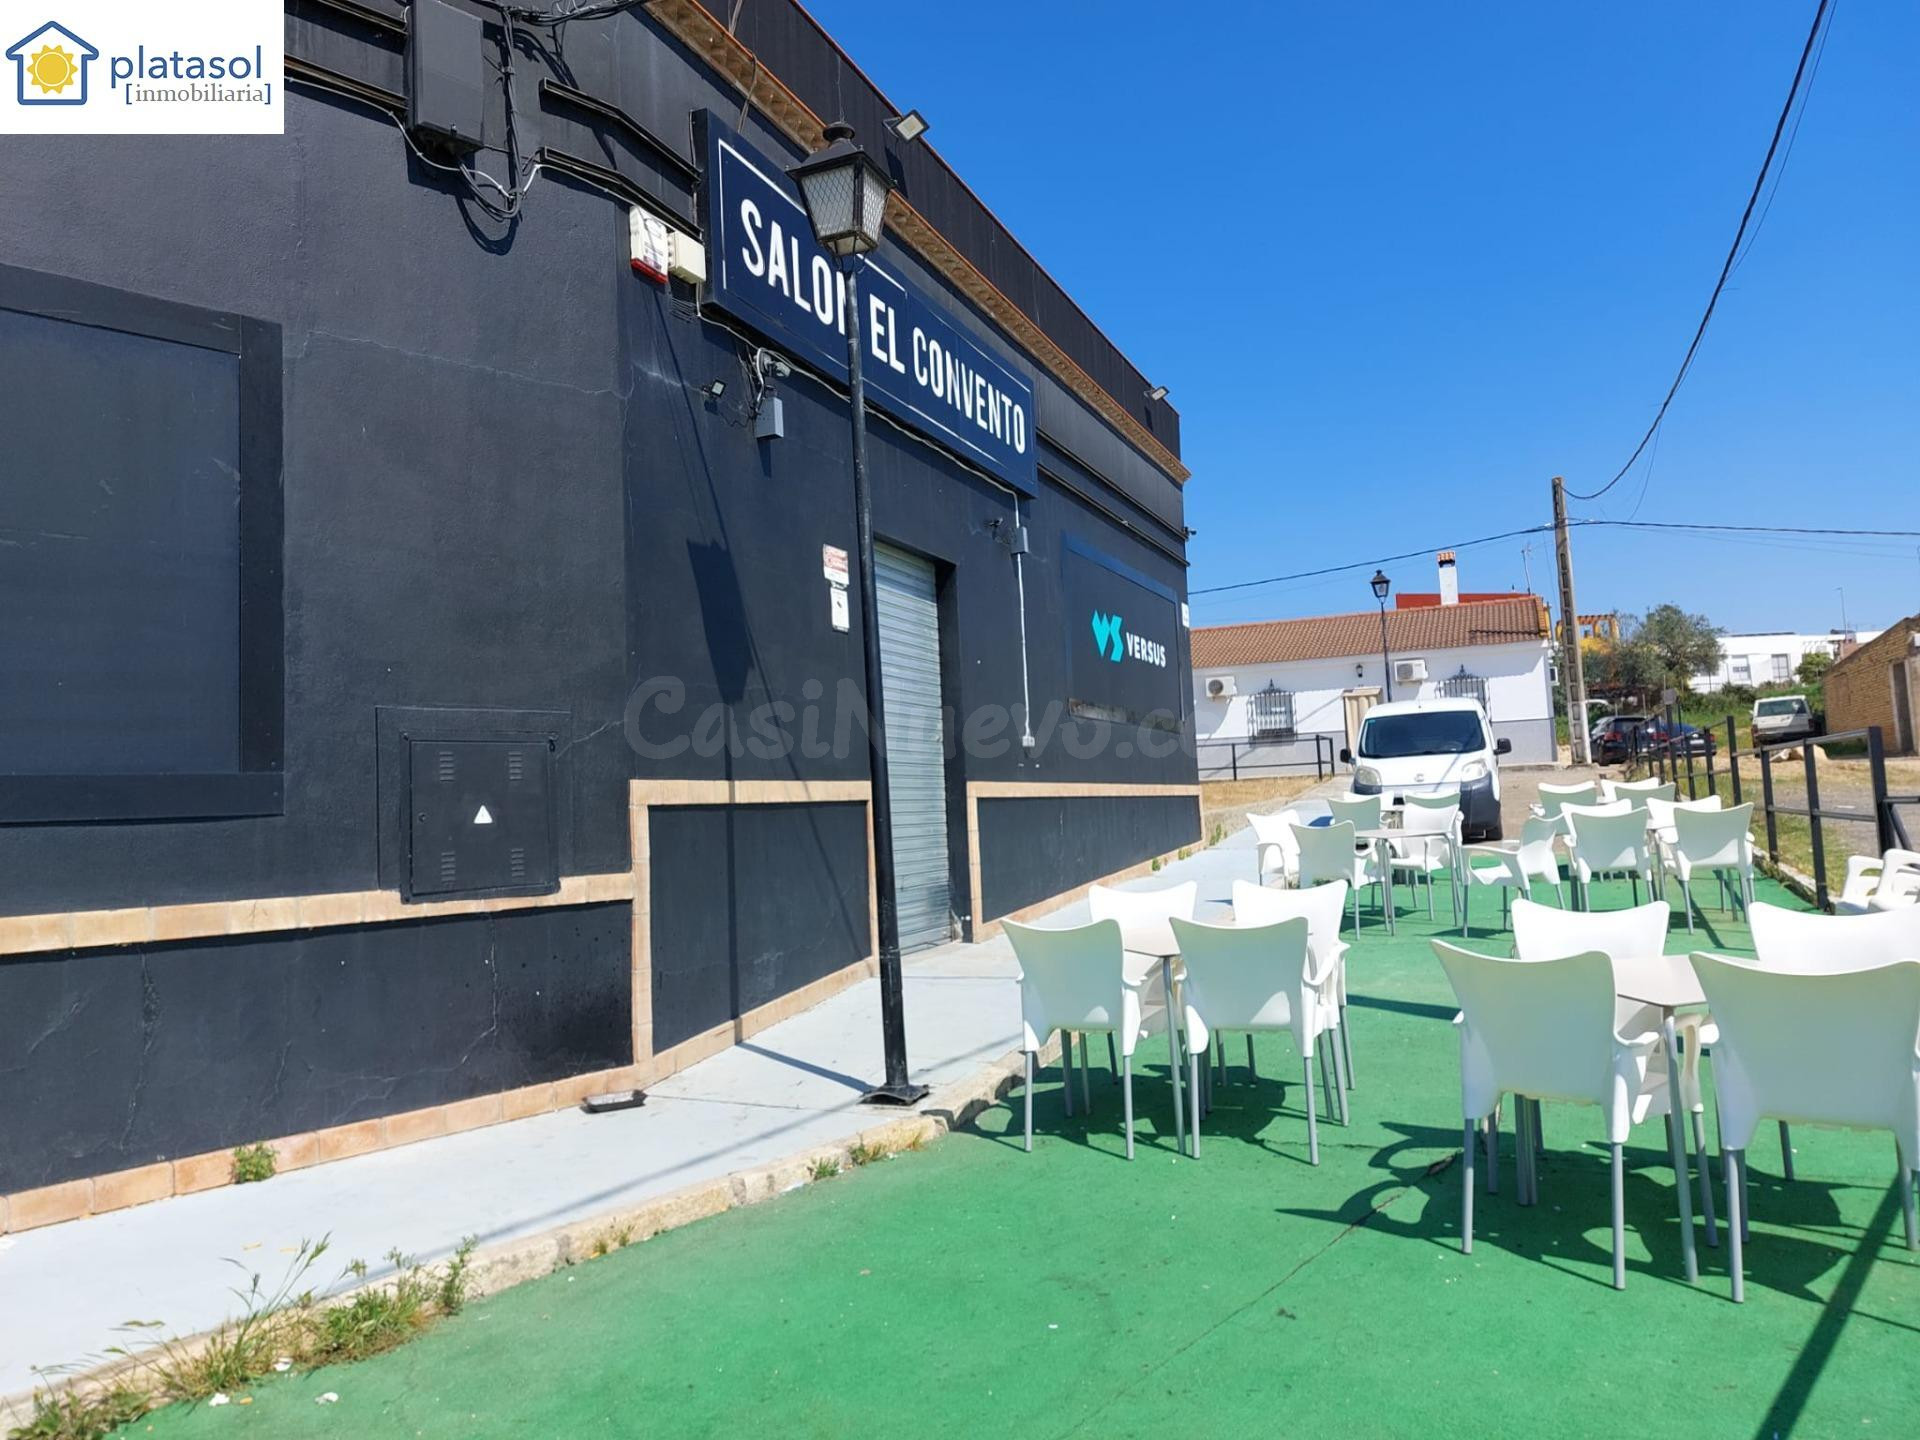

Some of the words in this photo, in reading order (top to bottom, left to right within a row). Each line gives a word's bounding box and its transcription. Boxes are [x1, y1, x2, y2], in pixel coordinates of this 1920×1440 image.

[869, 293, 906, 374] EL
[913, 327, 1026, 454] CONVENTO
[1126, 632, 1166, 668] VERSUS
